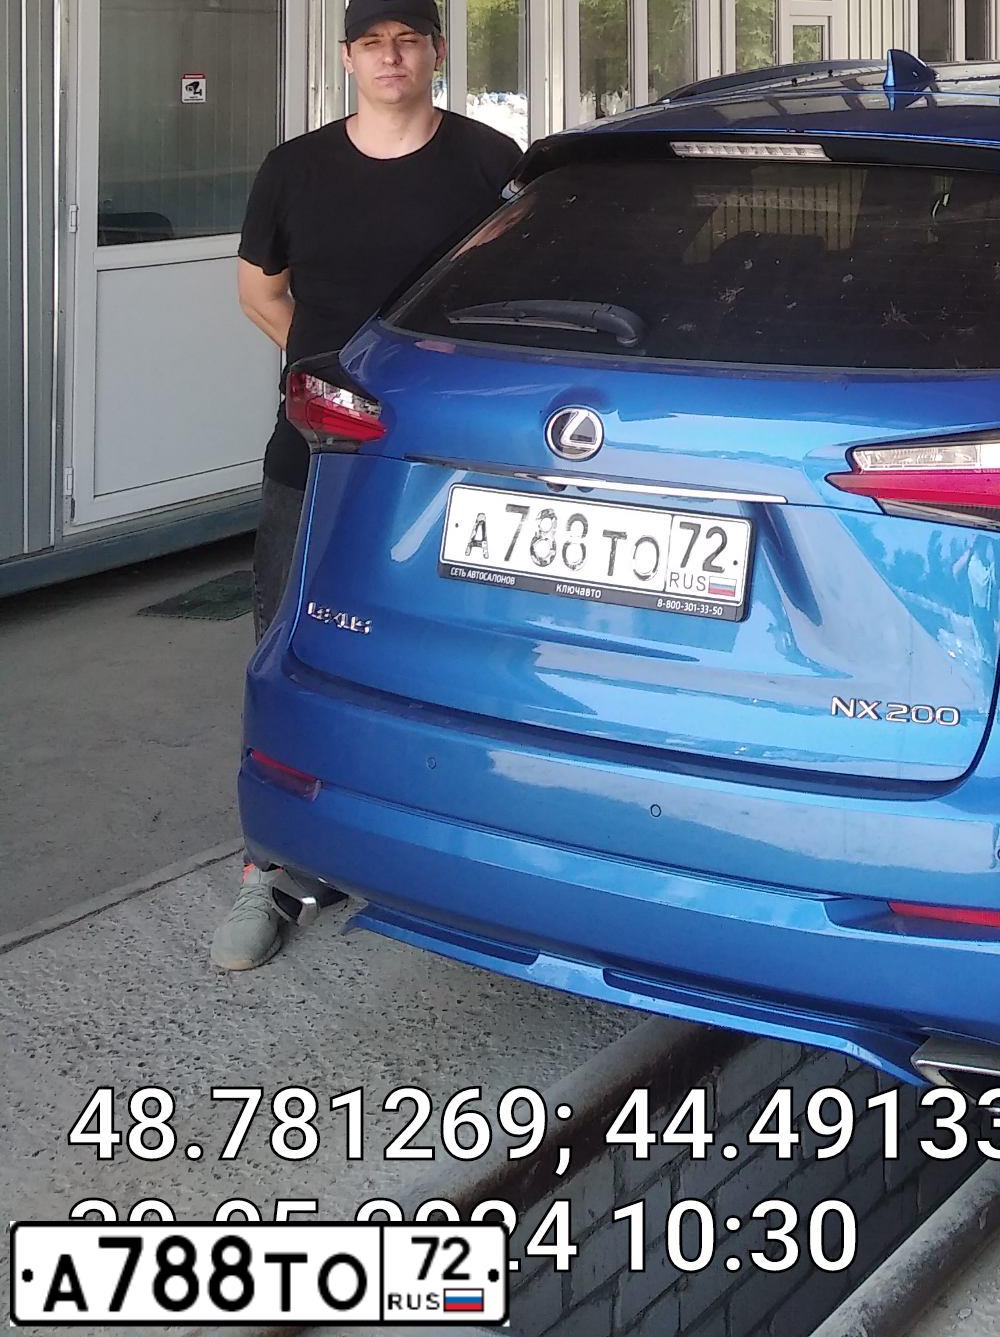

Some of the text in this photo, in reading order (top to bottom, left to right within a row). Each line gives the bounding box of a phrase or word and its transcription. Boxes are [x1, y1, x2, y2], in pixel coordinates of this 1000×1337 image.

[679, 521, 729, 574] 72
[450, 566, 516, 586] СЕТЬ АВТОСАЛОНОВ
[668, 571, 706, 592] RUS
[656, 598, 724, 616] 8-800-301-33-50
[831, 696, 961, 726] NX 200
